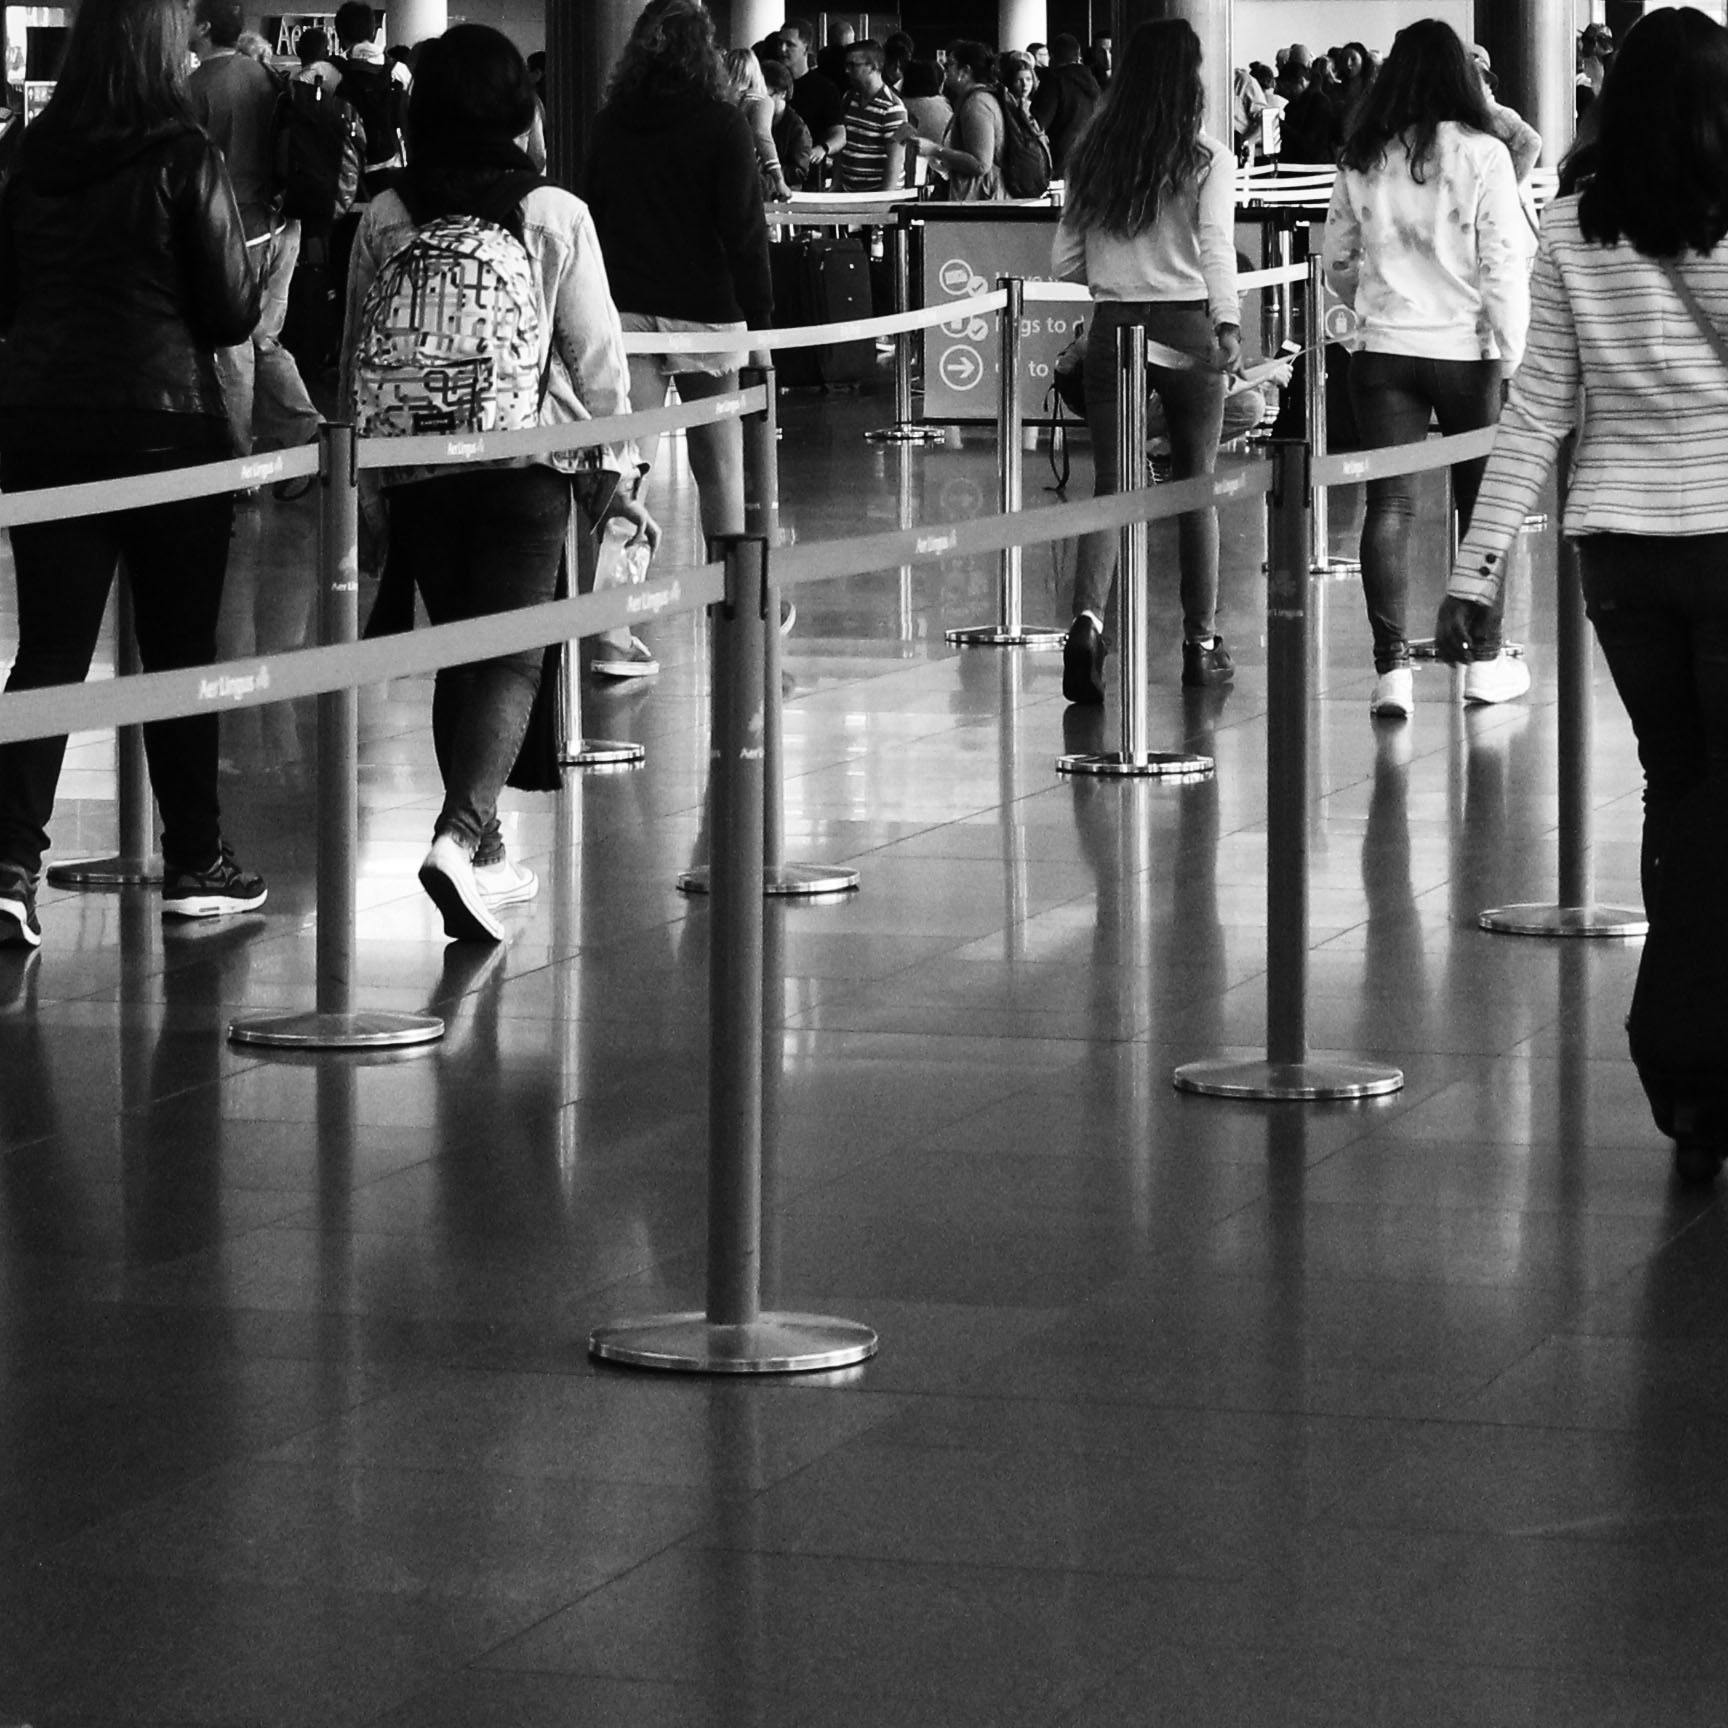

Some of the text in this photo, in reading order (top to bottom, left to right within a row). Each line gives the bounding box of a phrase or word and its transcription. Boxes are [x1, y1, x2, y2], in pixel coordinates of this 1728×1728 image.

[1045, 316, 1067, 334] to
[1028, 361, 1050, 378] to
[198, 675, 255, 701] Aer Lingus
